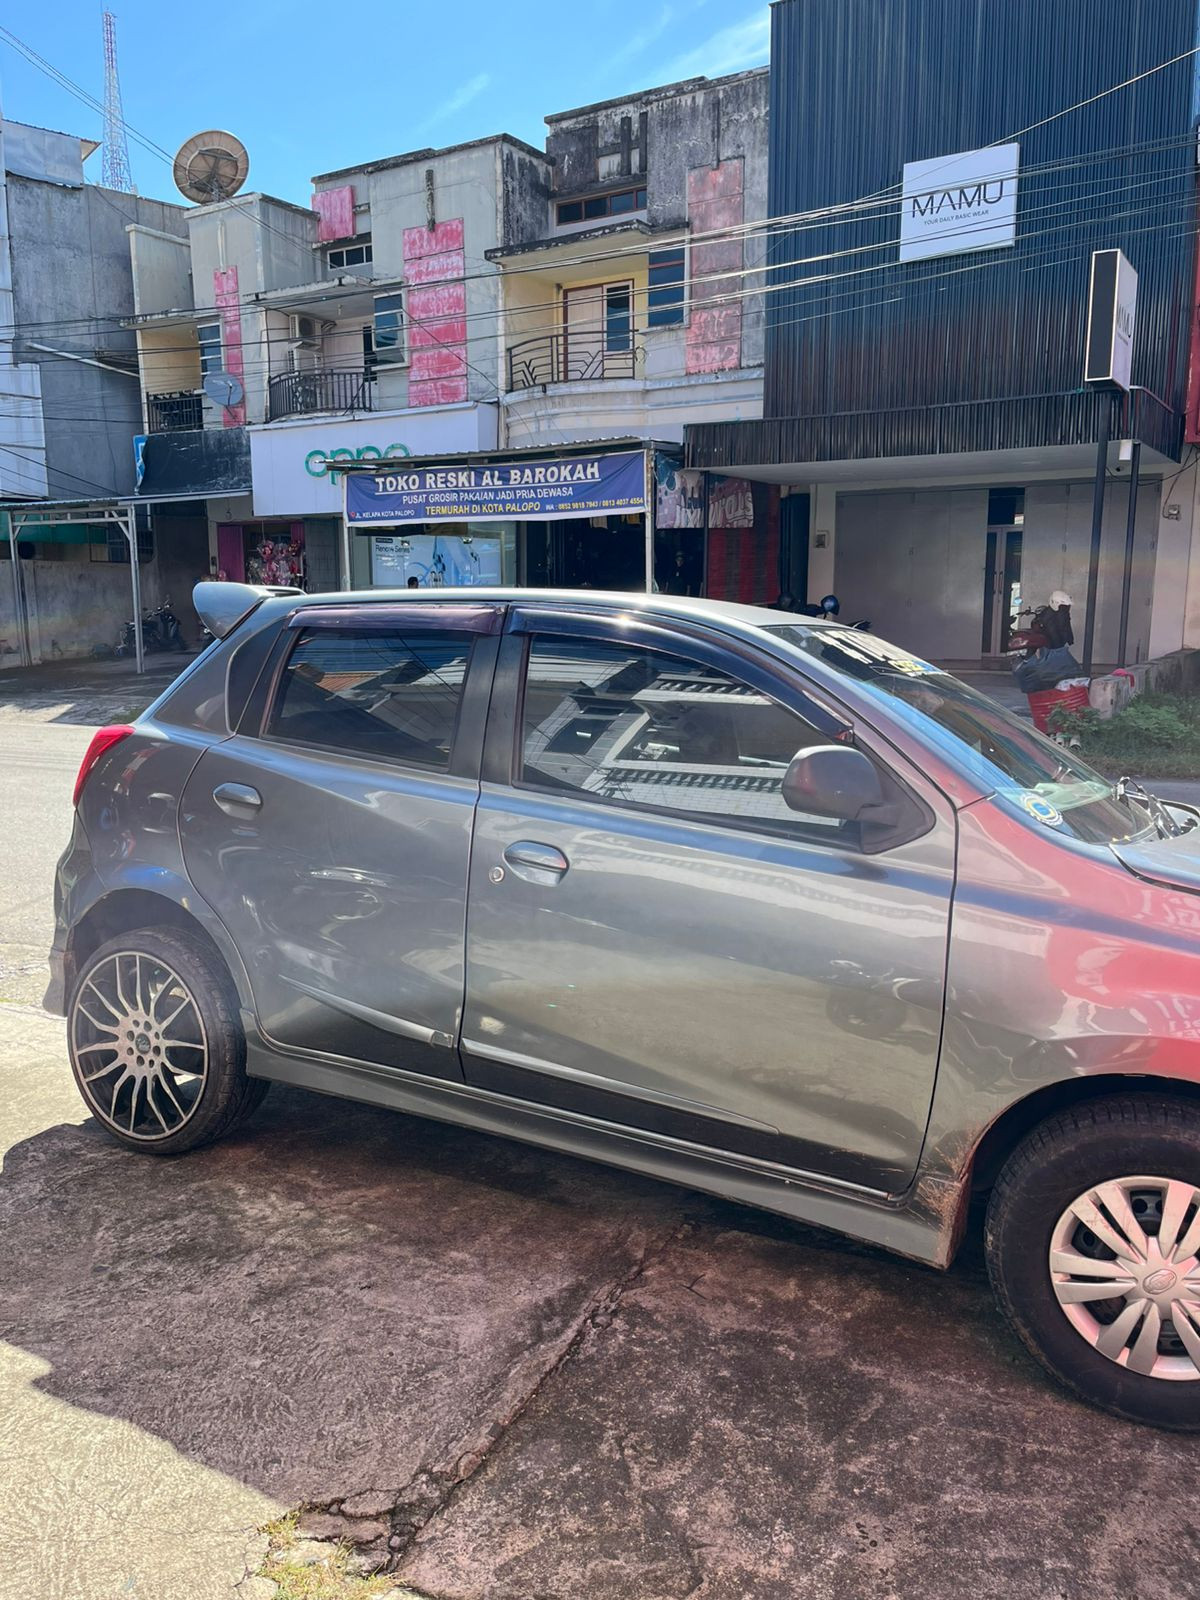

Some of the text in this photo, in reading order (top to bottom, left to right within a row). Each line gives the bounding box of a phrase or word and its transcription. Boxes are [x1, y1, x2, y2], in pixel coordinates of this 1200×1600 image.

[912, 180, 1003, 218] MAMU
[940, 216, 954, 224] DAILY
[955, 213, 972, 221] BASIC
[973, 209, 989, 218] WEAR
[374, 461, 600, 492] TOKO RESKI AL BAROKAH
[402, 486, 574, 505] PUSAT GROSIR PAKAIAN JADI PRIA DEWASA
[425, 501, 541, 516] TERMURAH DI KOTA PALOPO
